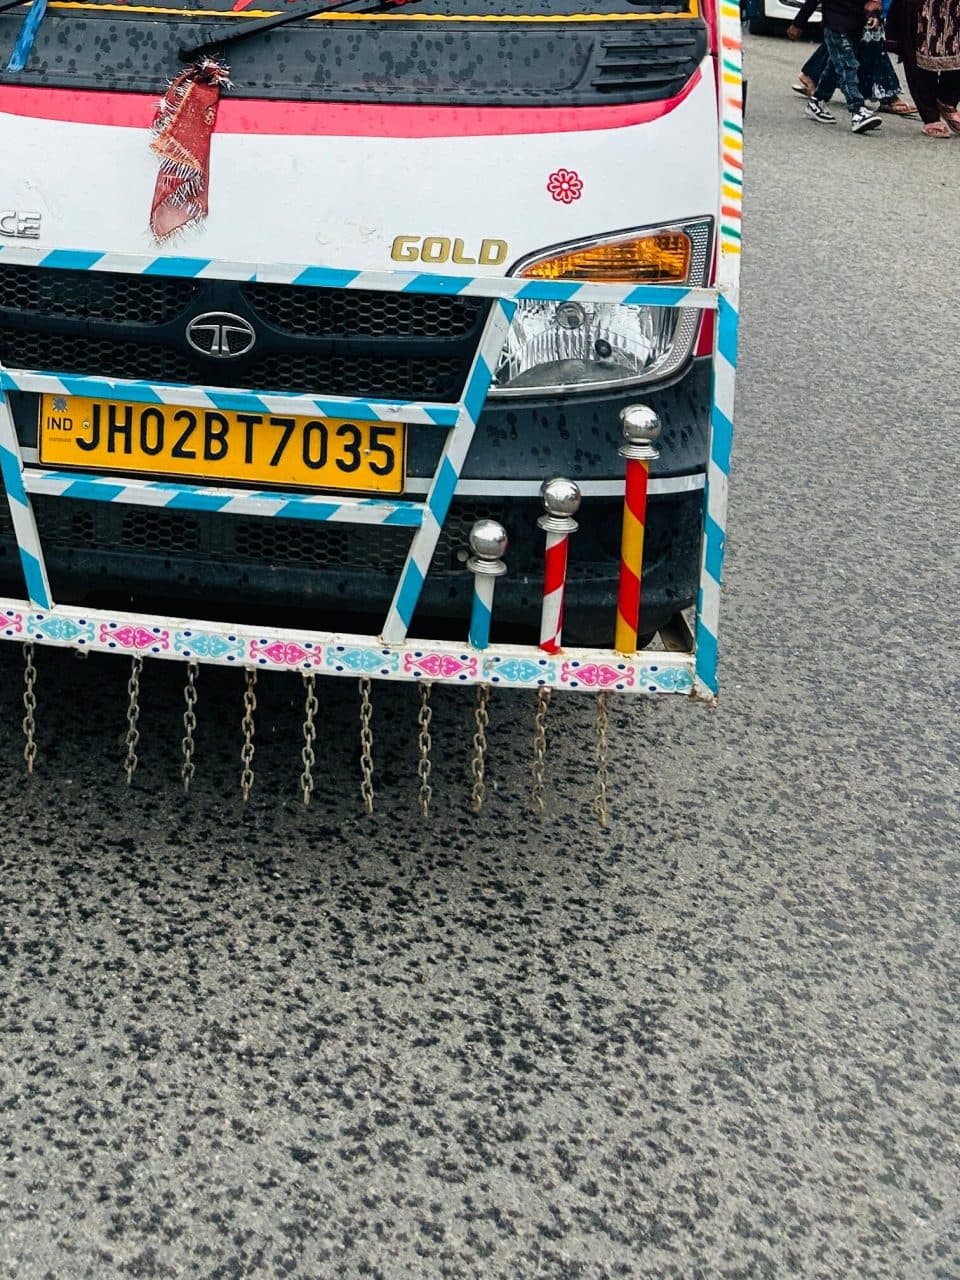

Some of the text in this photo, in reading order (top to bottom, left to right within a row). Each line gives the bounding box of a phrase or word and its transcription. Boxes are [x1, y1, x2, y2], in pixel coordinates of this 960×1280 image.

[390, 235, 509, 265] GOLD
[47, 402, 397, 476] IND JH02BT7035
